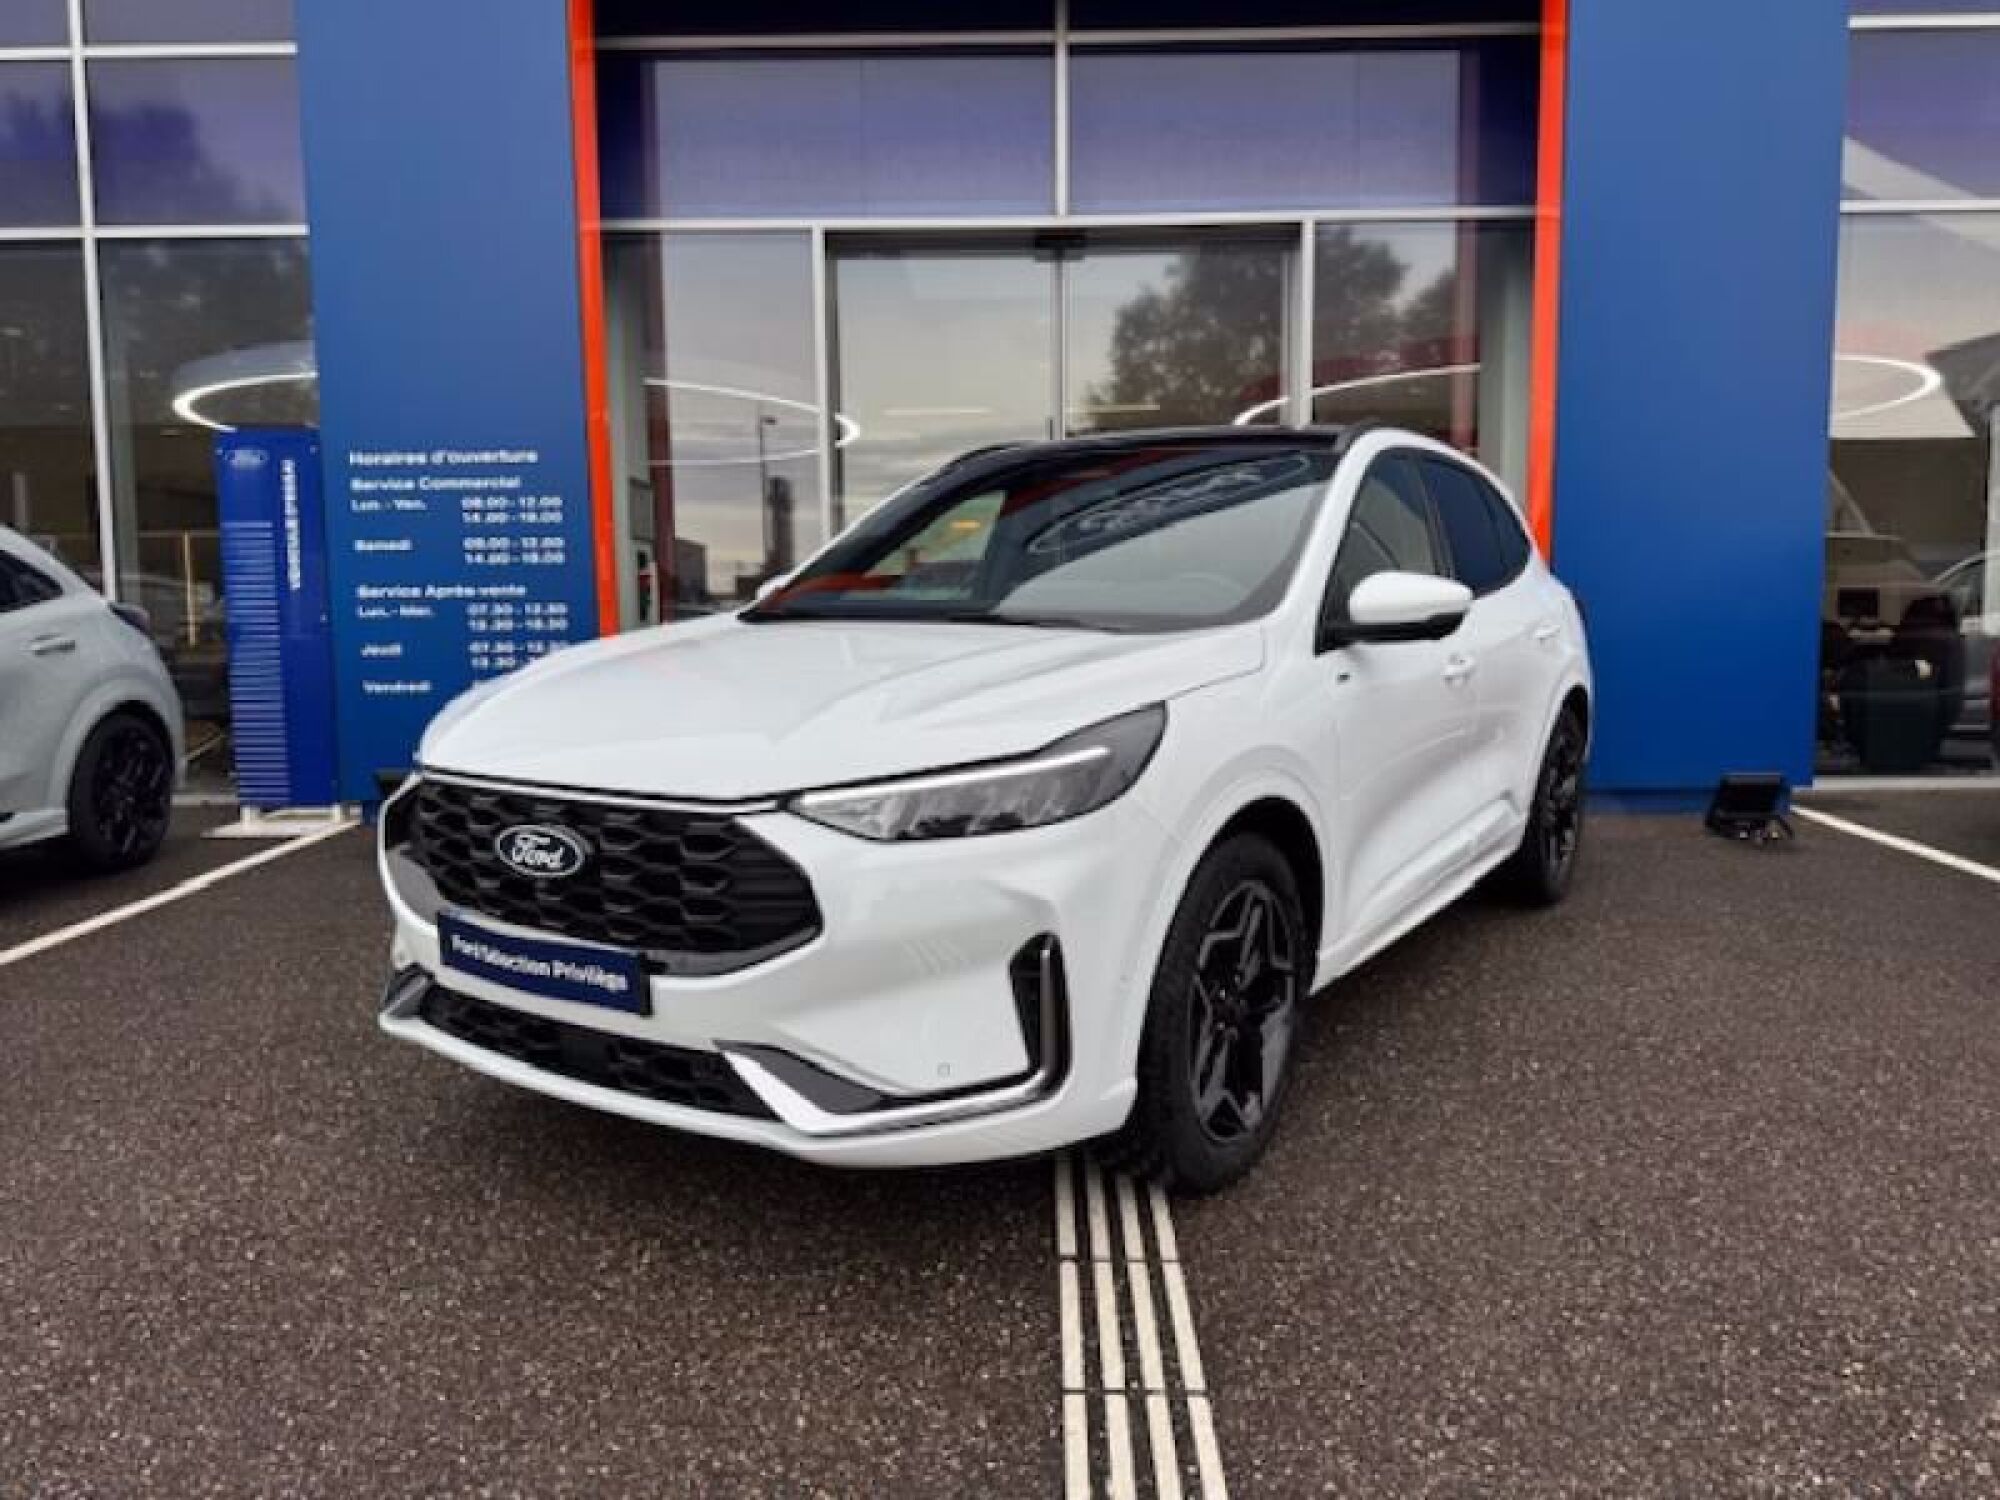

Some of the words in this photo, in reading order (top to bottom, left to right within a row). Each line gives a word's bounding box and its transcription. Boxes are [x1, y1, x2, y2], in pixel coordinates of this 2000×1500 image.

[350, 452, 426, 466] Horaires
[430, 450, 538, 464] d'ouverture
[352, 478, 415, 491] Service
[419, 476, 521, 490] Commercial
[355, 540, 412, 551] Samedi
[358, 585, 421, 598] Service
[362, 644, 402, 657] Jeudi
[363, 681, 430, 693] Vendredi
[512, 834, 564, 868] Ford
